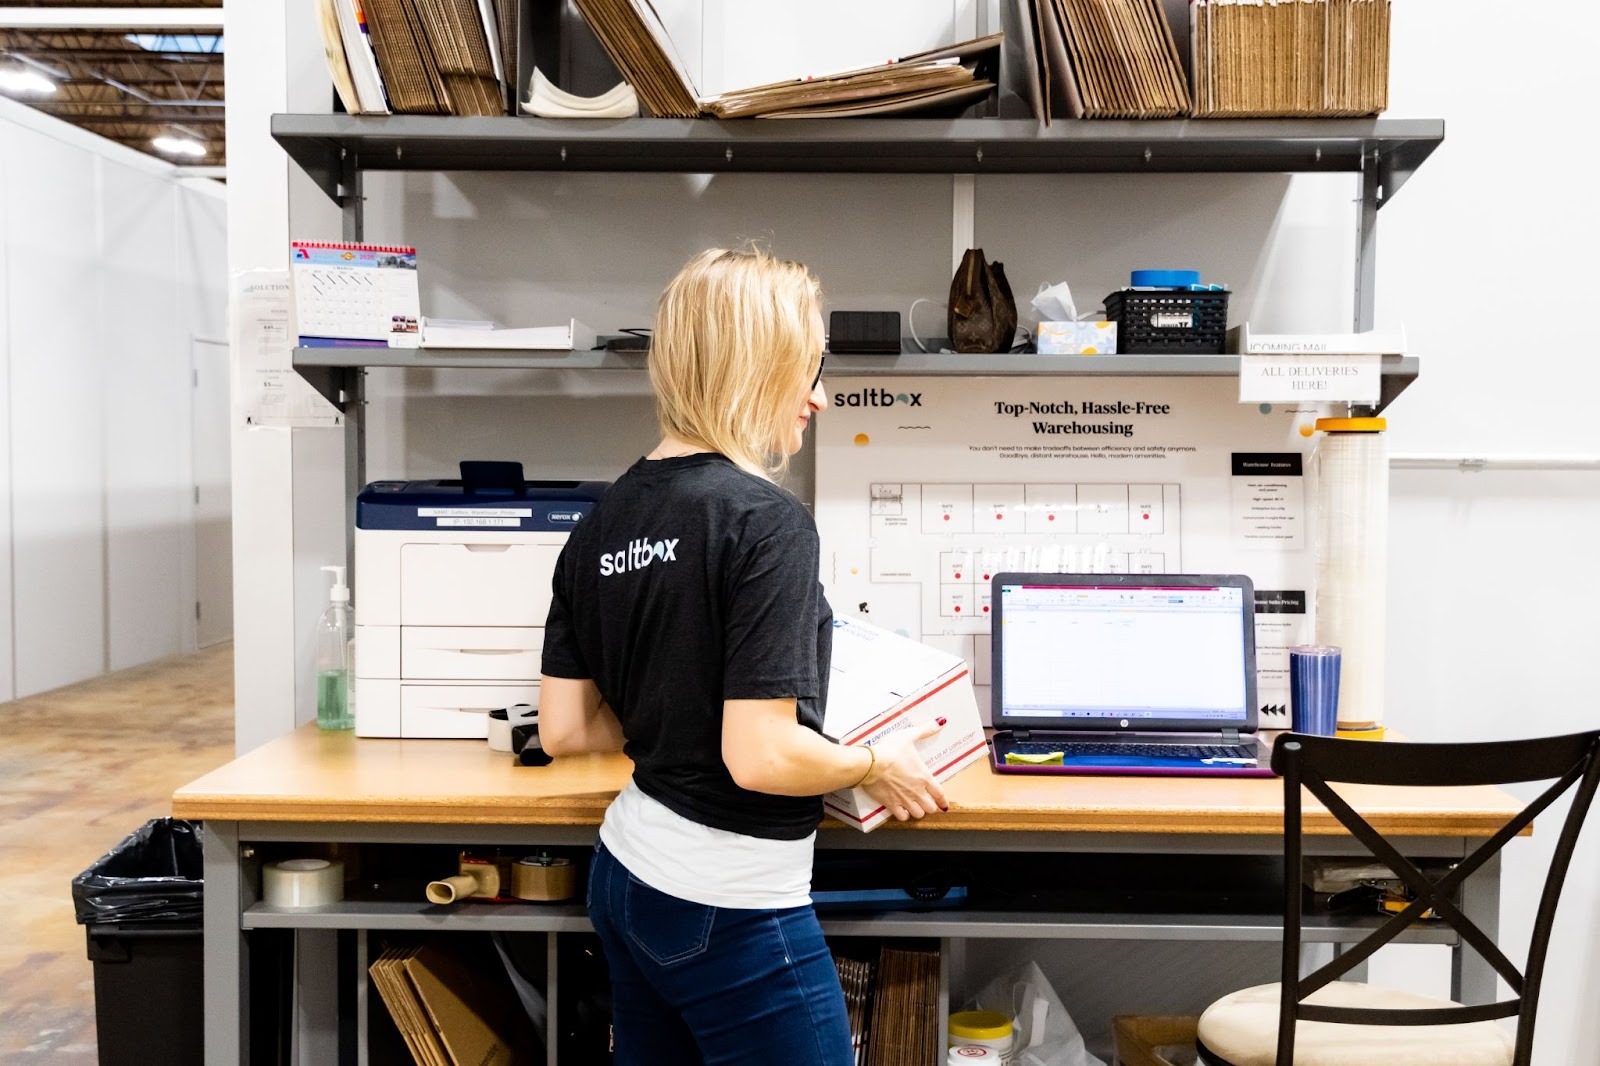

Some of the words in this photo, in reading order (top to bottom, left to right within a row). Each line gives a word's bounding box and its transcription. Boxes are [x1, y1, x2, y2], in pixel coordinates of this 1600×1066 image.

[1261, 367, 1285, 376] ALL
[1288, 366, 1359, 376] DELIVERIES
[1292, 380, 1327, 390] HERE!
[834, 388, 922, 407] saltbox
[994, 400, 1078, 417] Top-Notch,
[1081, 400, 1171, 415] Hassle-Free
[1032, 421, 1134, 438] Warehousing
[600, 537, 679, 576] saltbox
[872, 727, 892, 743] UNITED
